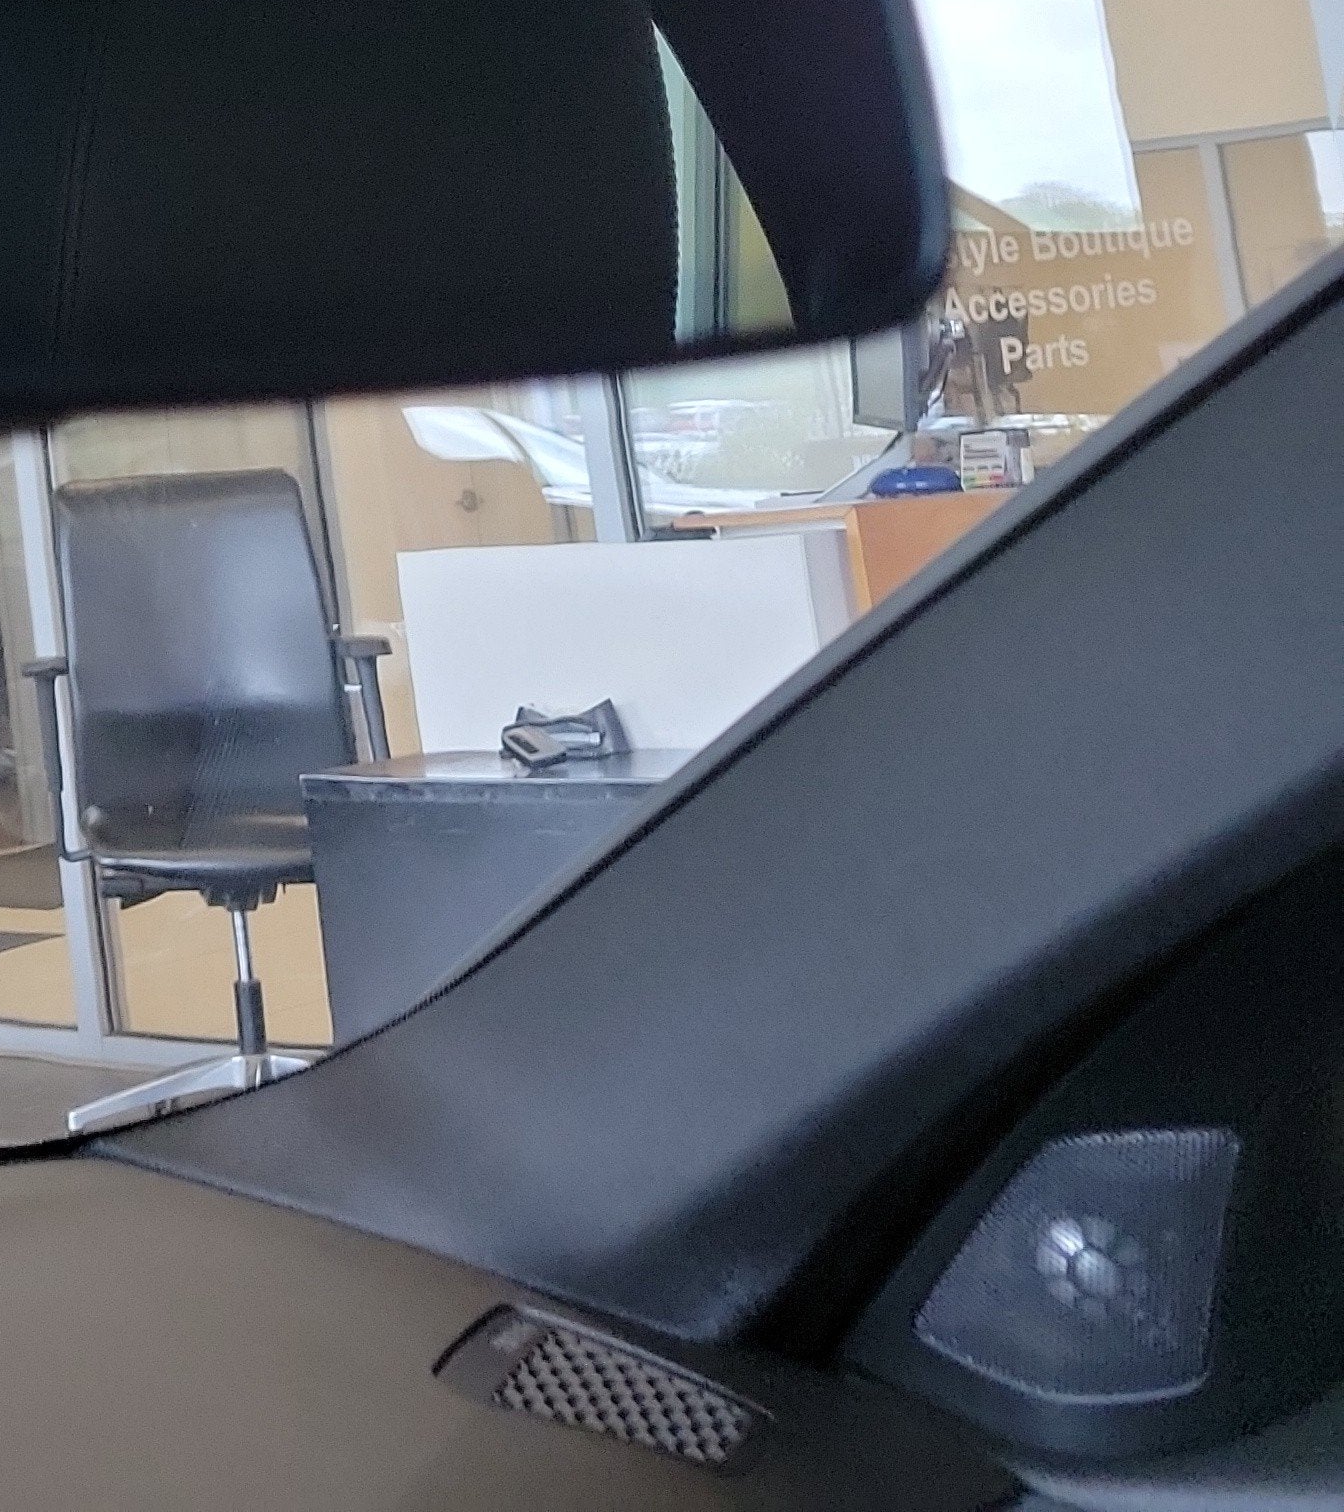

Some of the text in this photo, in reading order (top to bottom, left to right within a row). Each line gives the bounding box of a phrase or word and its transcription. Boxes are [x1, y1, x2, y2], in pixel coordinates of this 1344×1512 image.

[1030, 217, 1194, 262] Boutique
[945, 274, 1157, 324] Accessories
[999, 334, 1090, 375] Parts
